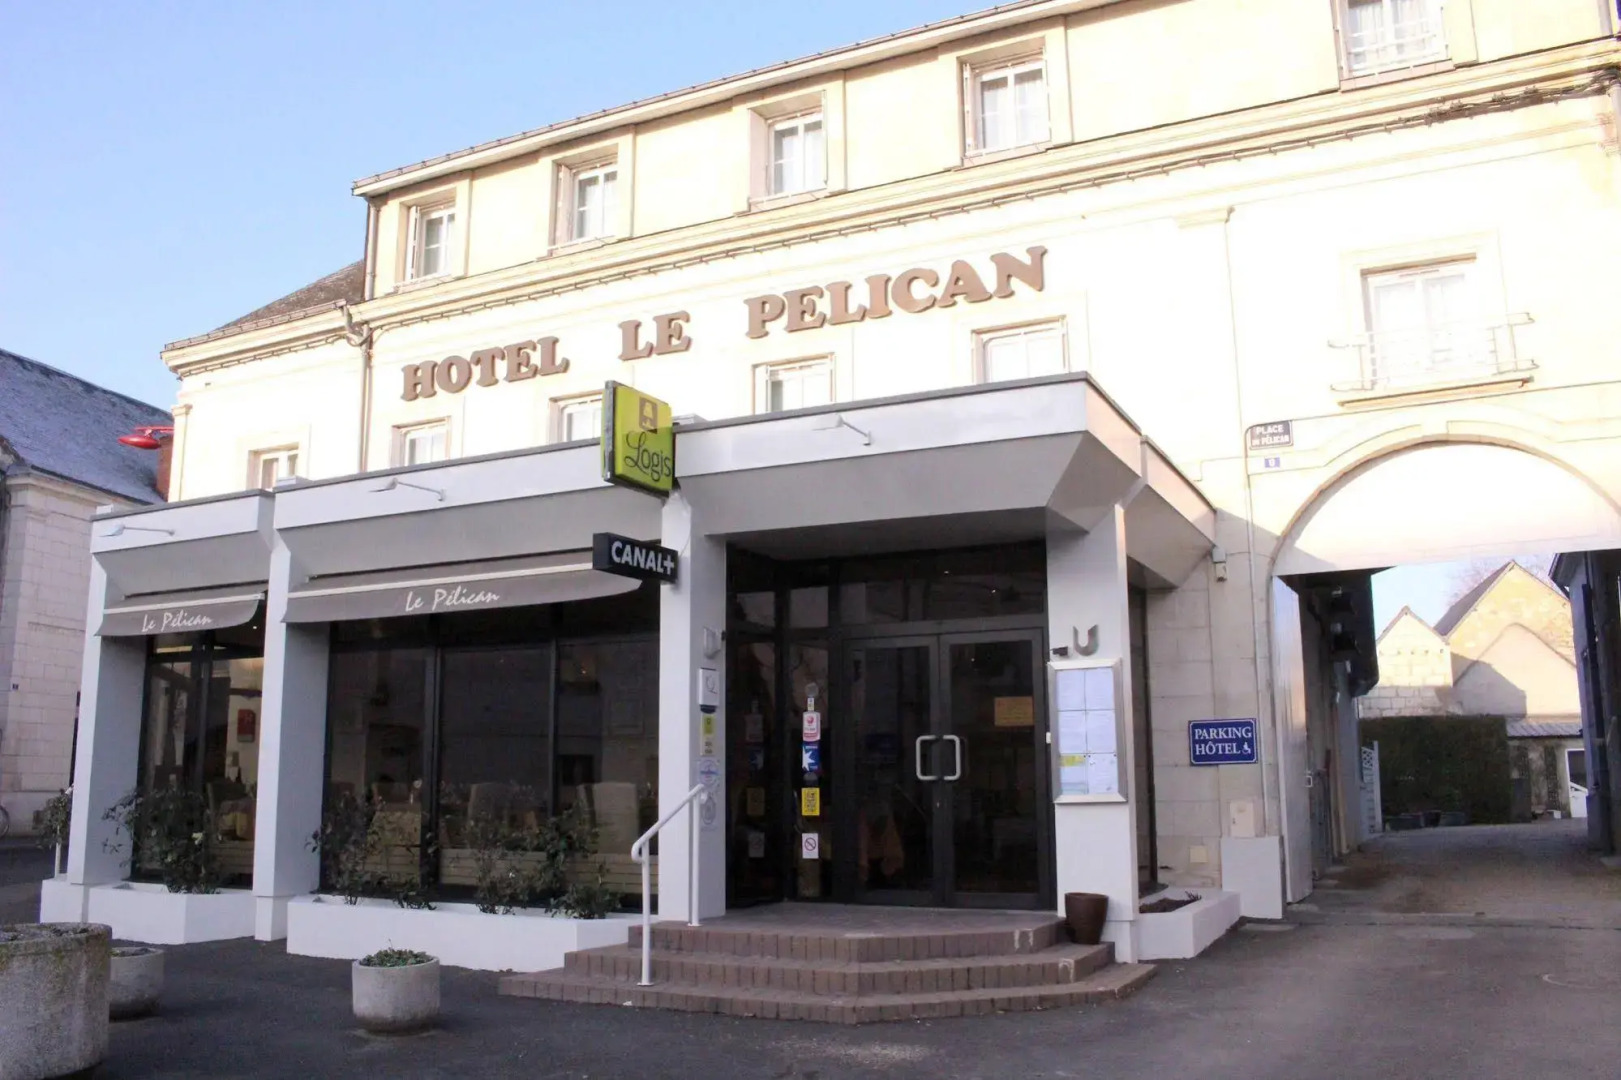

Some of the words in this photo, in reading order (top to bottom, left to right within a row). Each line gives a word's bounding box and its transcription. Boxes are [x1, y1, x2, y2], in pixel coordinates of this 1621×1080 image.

[400, 336, 570, 402] HOTEL
[618, 310, 693, 361] LE
[744, 245, 1048, 339] PELICAN
[1256, 424, 1284, 435] PLACE
[624, 430, 672, 482] Logis
[611, 540, 675, 576] CANAL+
[405, 591, 424, 612] Le
[432, 585, 500, 611] Pélican
[142, 614, 156, 632] Le
[161, 609, 212, 632] Pélican
[1194, 726, 1252, 740] PARKING
[1195, 741, 1241, 755] HÔTEL
